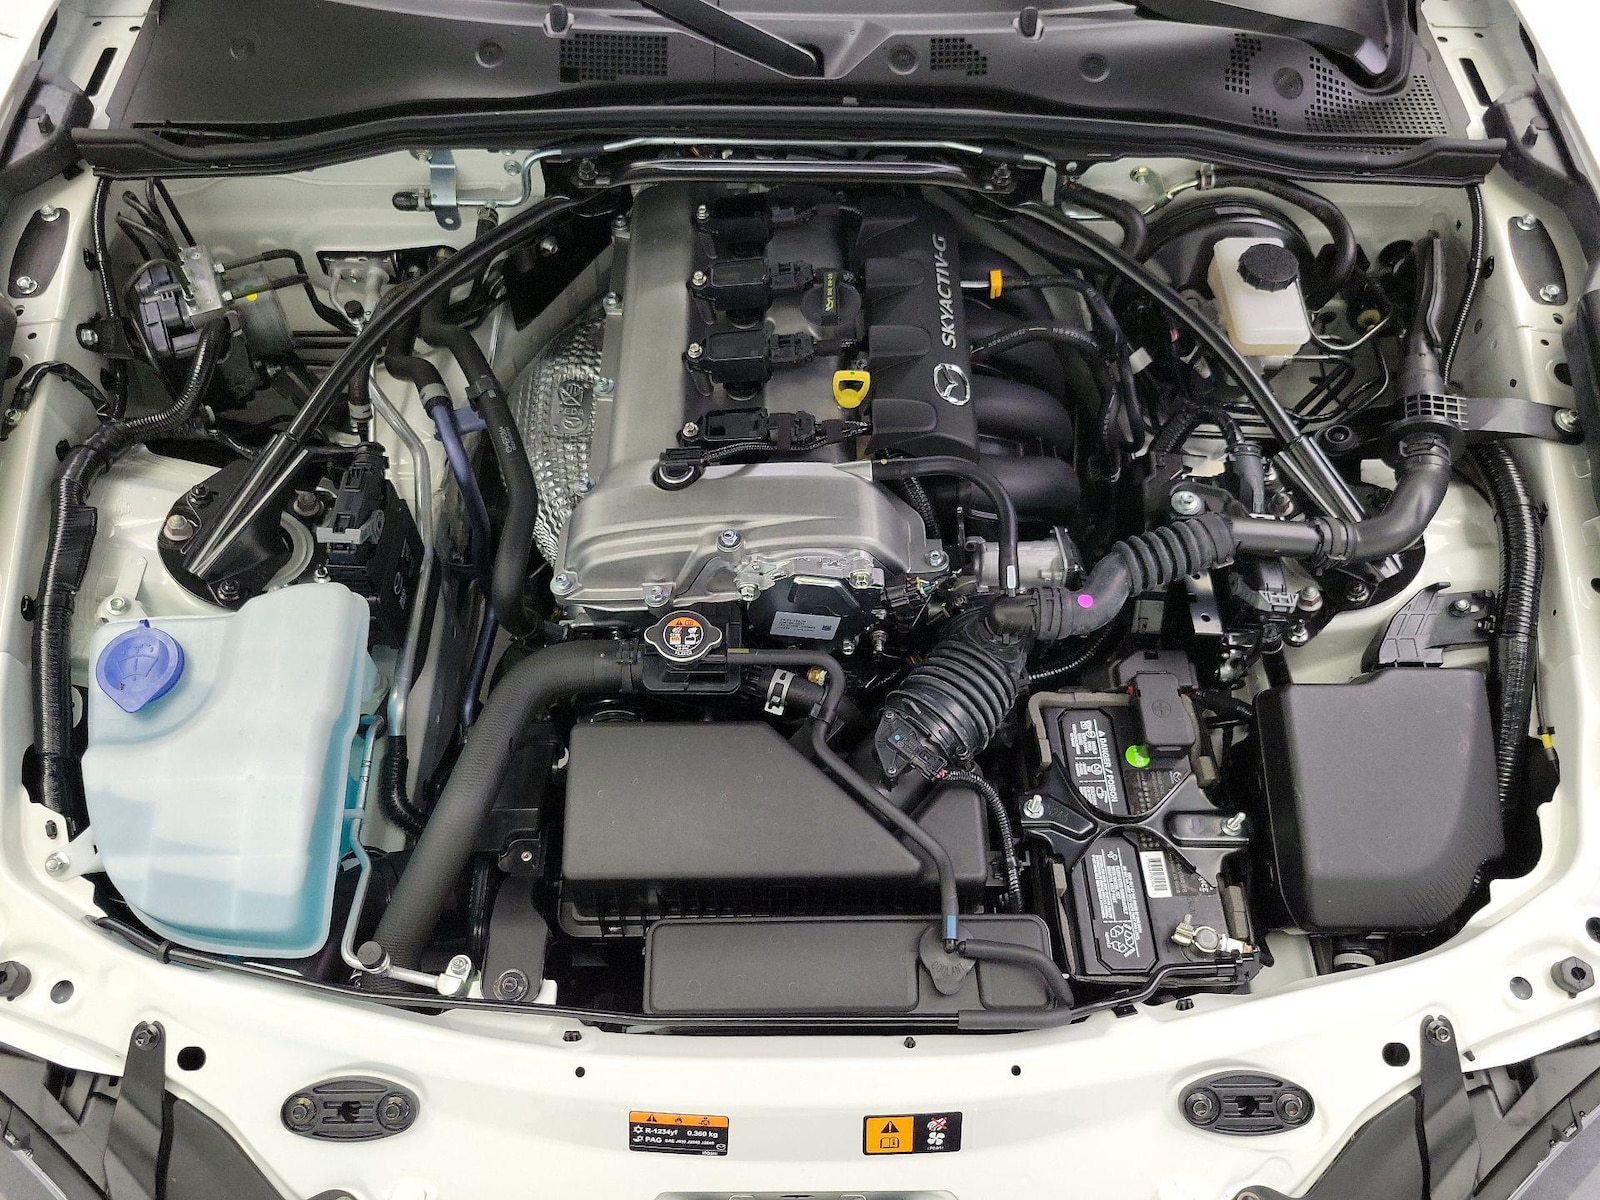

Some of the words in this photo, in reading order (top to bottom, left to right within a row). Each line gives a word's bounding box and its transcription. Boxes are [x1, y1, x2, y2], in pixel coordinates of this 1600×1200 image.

[931, 233, 956, 349] SKYACTIV-G
[1099, 737, 1113, 769] DANGER
[1106, 774, 1120, 802] POISON
[931, 960, 967, 978] COOLANT
[645, 1127, 679, 1136] R-1234yf
